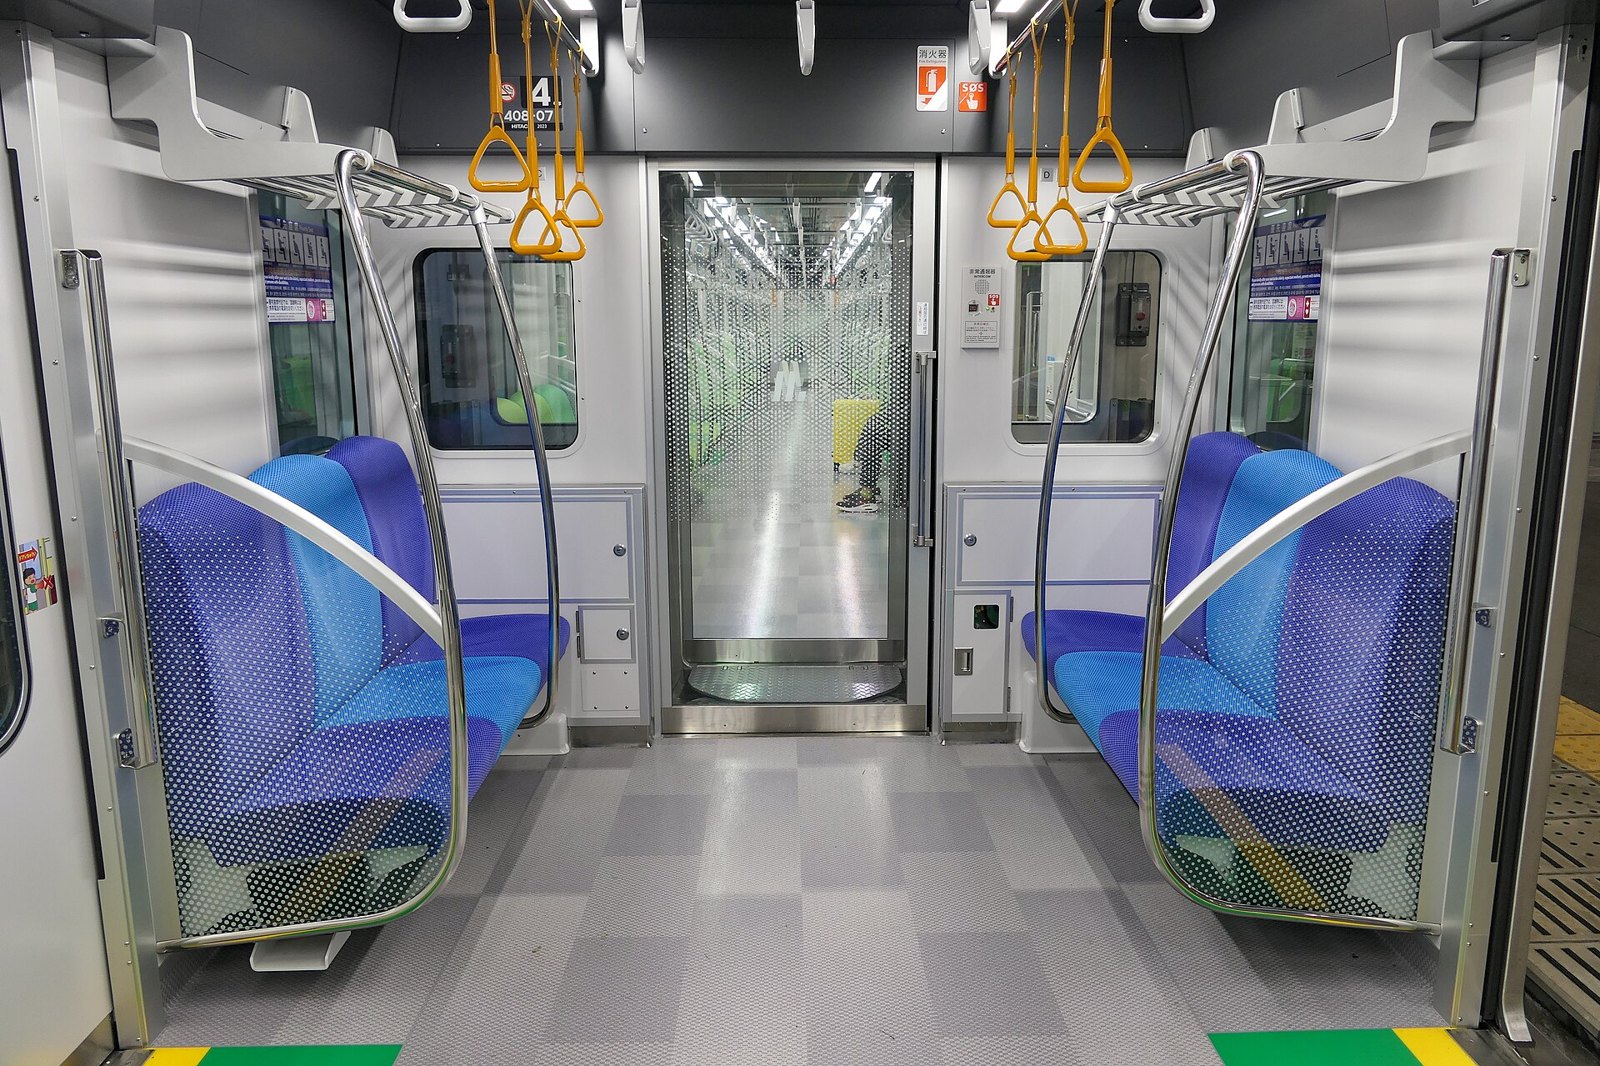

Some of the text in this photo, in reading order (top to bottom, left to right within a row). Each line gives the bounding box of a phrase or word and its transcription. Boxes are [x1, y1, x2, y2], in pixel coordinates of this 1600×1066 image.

[919, 49, 947, 59] 消火器
[532, 77, 551, 106] 4
[962, 83, 984, 93] SOS
[1044, 170, 1050, 178] D
